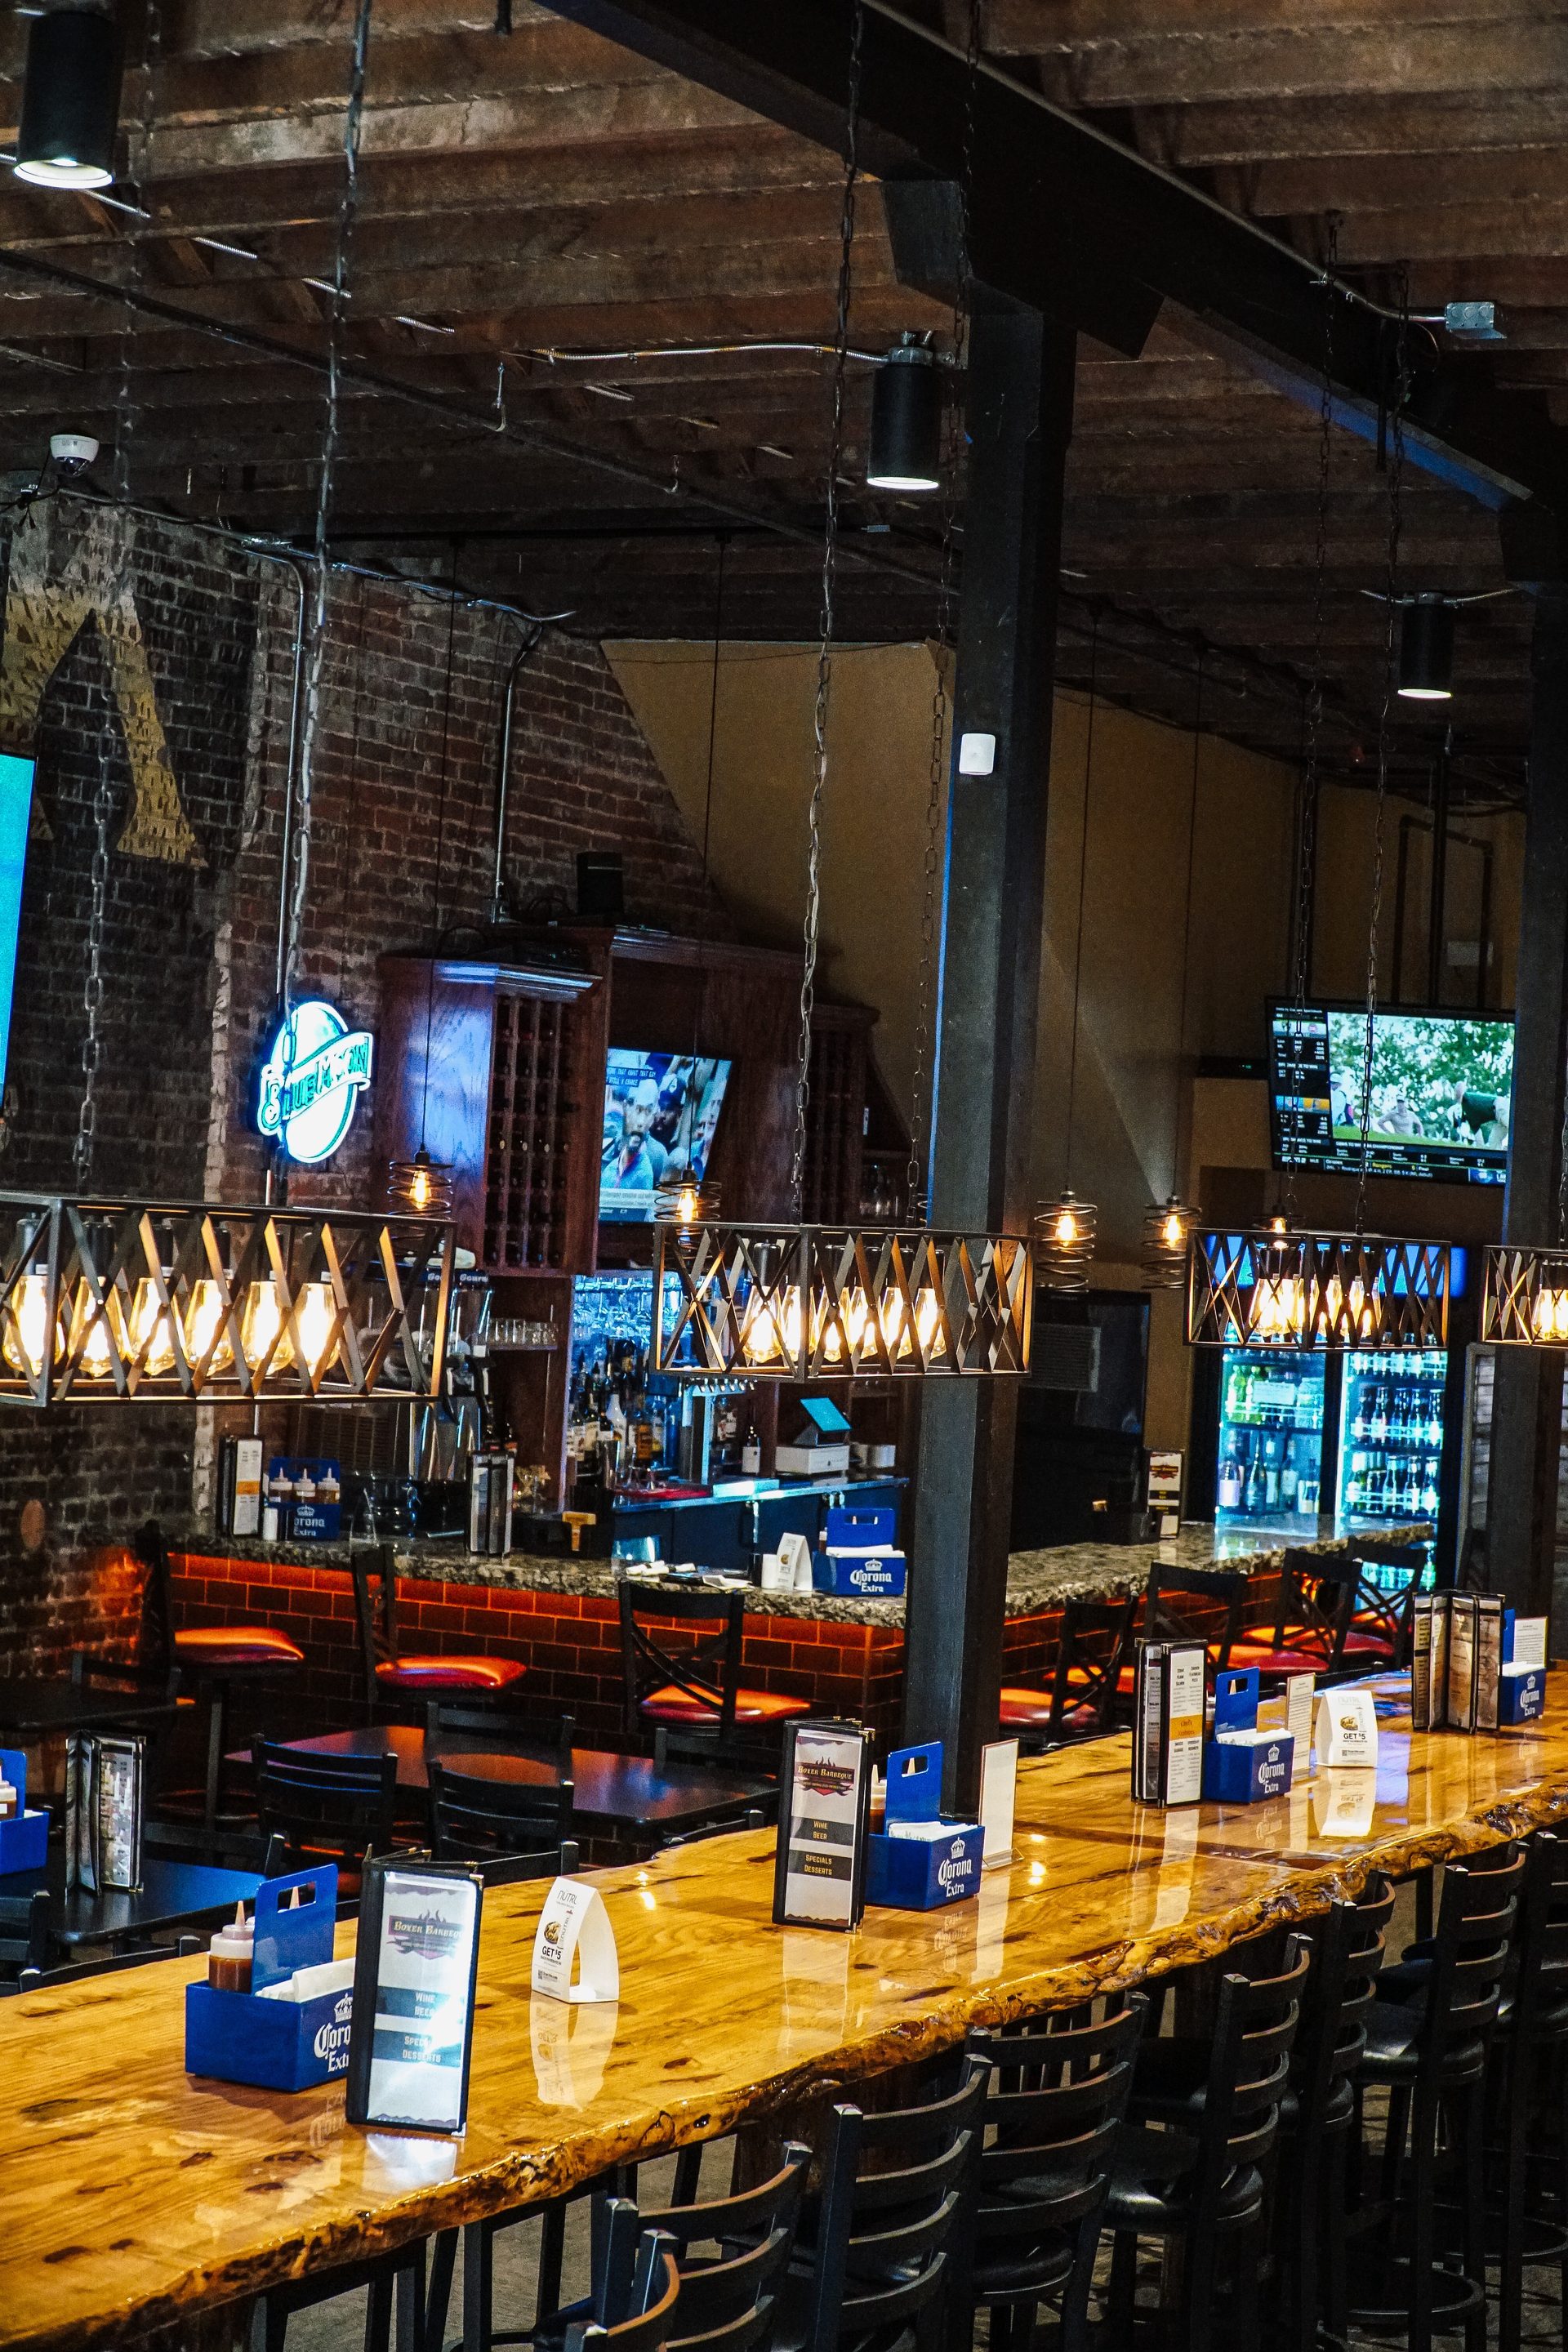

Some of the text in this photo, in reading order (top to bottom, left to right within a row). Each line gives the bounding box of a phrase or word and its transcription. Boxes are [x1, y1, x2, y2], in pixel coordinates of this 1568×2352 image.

[293, 1517, 326, 1527] orona
[849, 1569, 892, 1587] Corona
[861, 1583, 884, 1592] Extra
[1258, 1762, 1285, 1784] Corona
[1264, 1780, 1279, 1794] Extra
[805, 1854, 832, 1865] SPECIALS
[804, 1864, 832, 1876] DESSERTS
[938, 1858, 973, 1888] Corona
[946, 1880, 964, 1898] Extra
[541, 1944, 555, 1958] GET
[555, 1949, 563, 1961] $5
[314, 2022, 352, 2062] Coro
